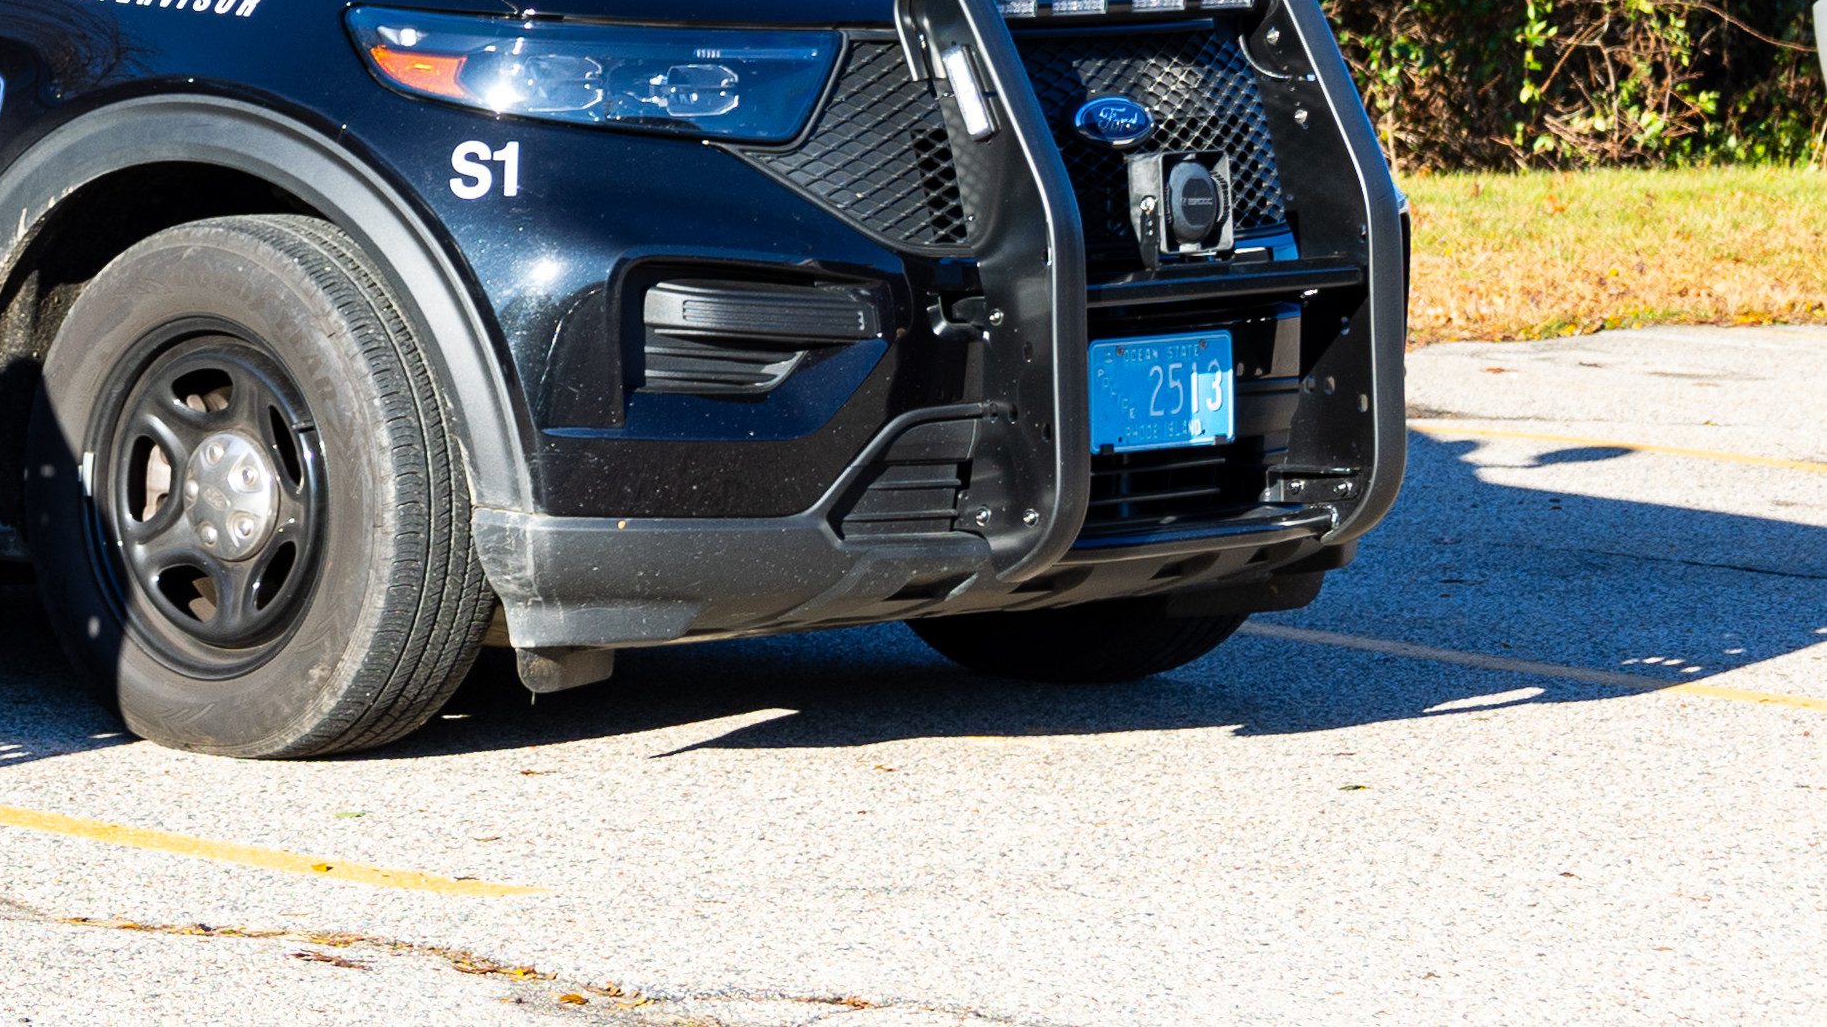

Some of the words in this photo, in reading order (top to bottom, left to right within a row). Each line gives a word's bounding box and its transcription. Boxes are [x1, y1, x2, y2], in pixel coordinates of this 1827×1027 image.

[1098, 107, 1138, 132] Ford
[449, 140, 519, 200] S1
[1124, 348, 1158, 362] OCEAN
[1168, 343, 1199, 358] STATE
[1149, 358, 1223, 416] 2513
[1164, 418, 1202, 438] ISLAND
